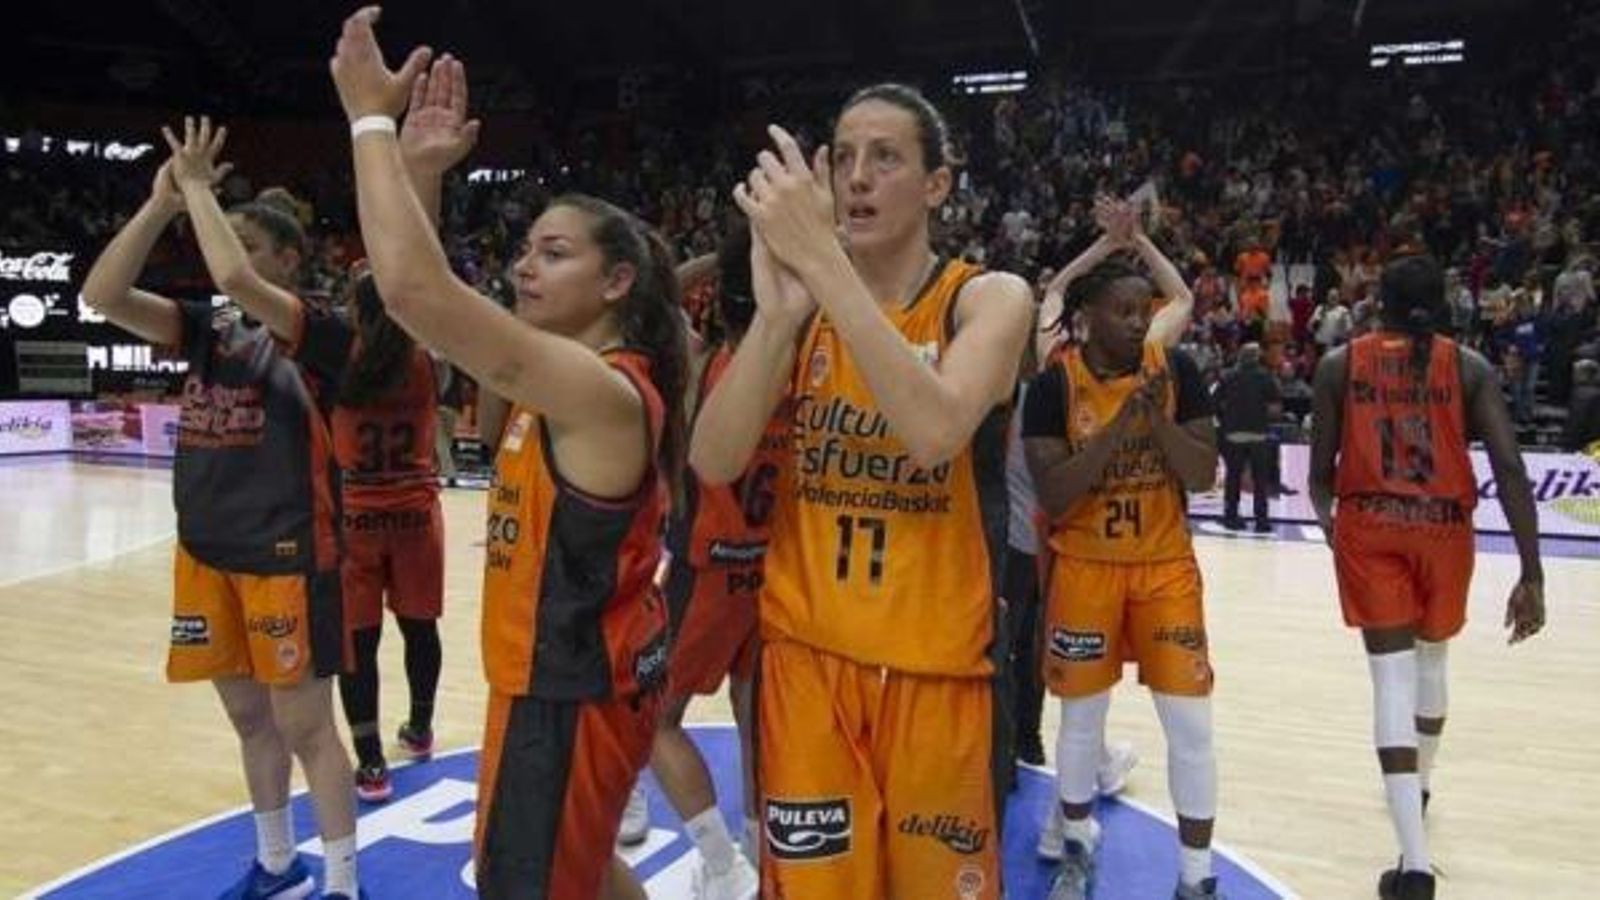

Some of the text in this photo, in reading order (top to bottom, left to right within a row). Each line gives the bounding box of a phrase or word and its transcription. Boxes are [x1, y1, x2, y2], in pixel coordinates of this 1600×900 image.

[1104, 500, 1141, 539] 24
[837, 514, 886, 585] 17
[767, 806, 846, 826] PULEVA
